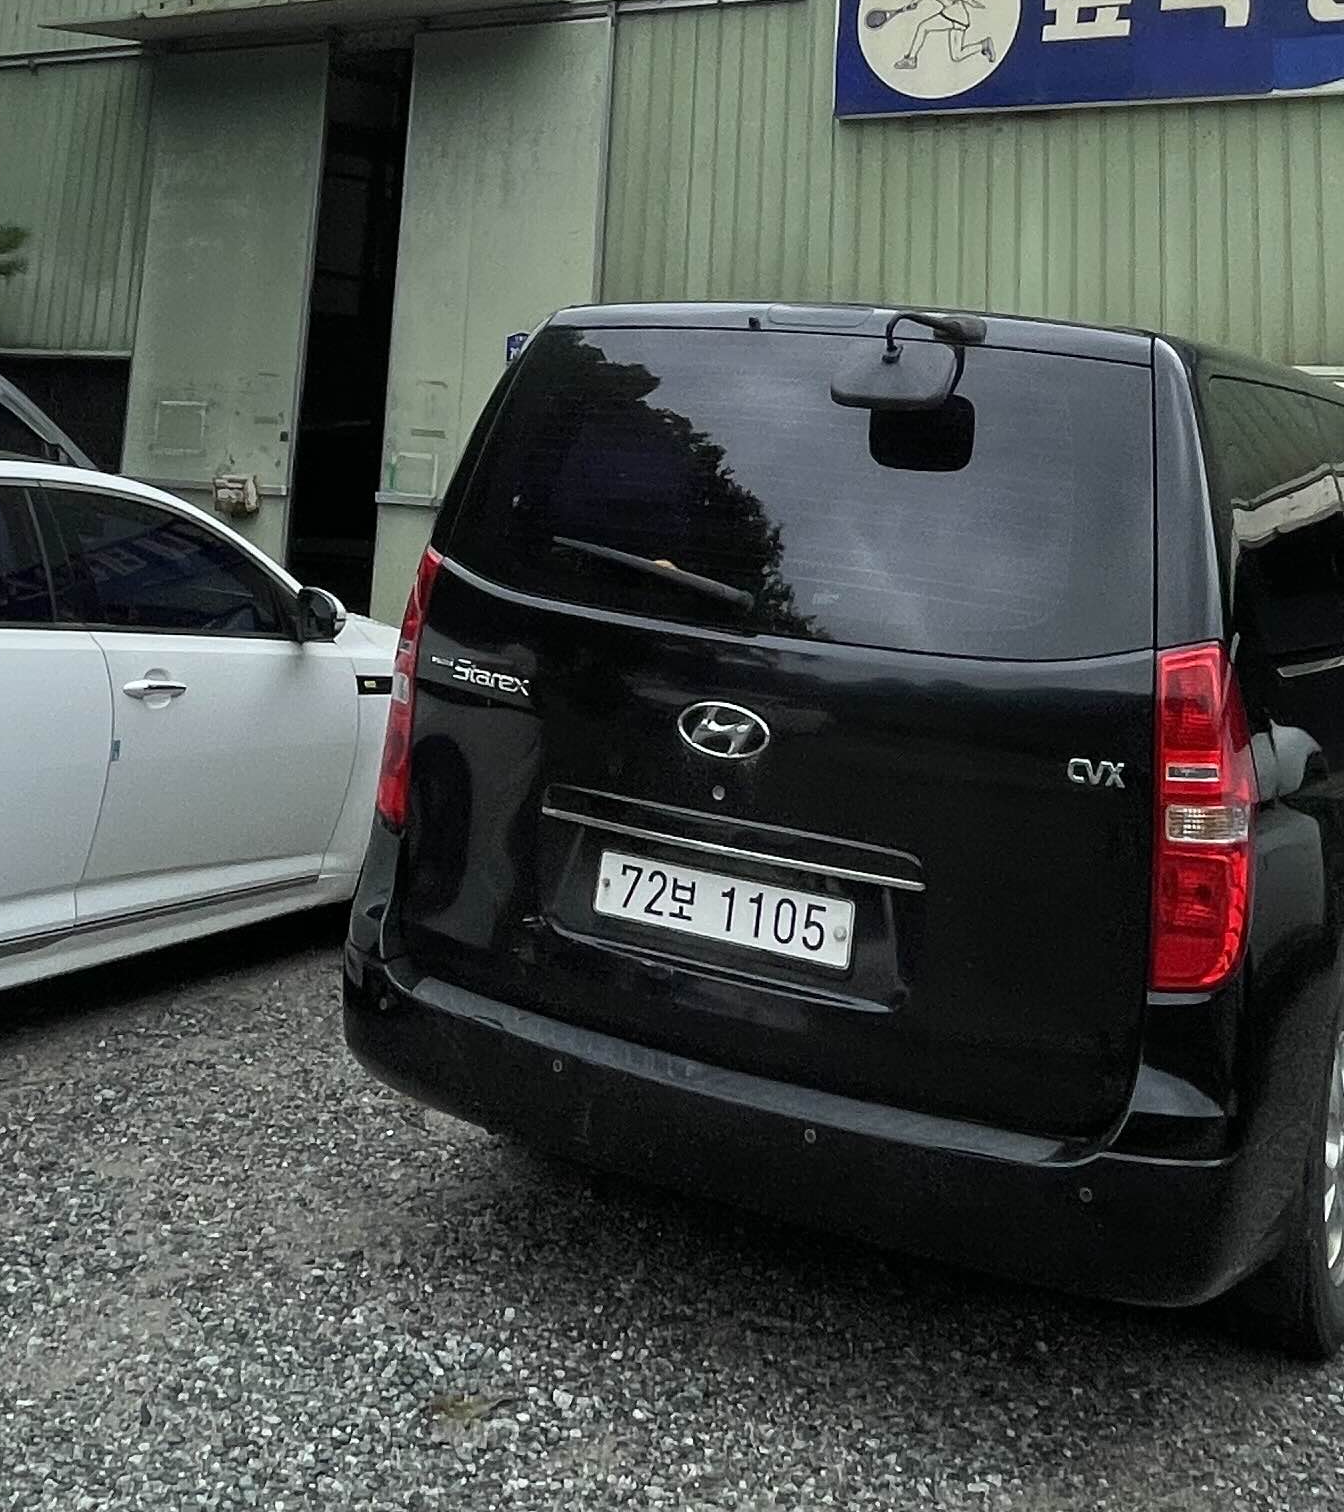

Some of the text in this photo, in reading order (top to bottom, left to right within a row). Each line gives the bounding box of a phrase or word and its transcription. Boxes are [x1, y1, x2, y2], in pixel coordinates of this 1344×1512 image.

[453, 658, 530, 696] Starex
[1067, 757, 1125, 788] CVX
[621, 864, 827, 951] 72보 1105
